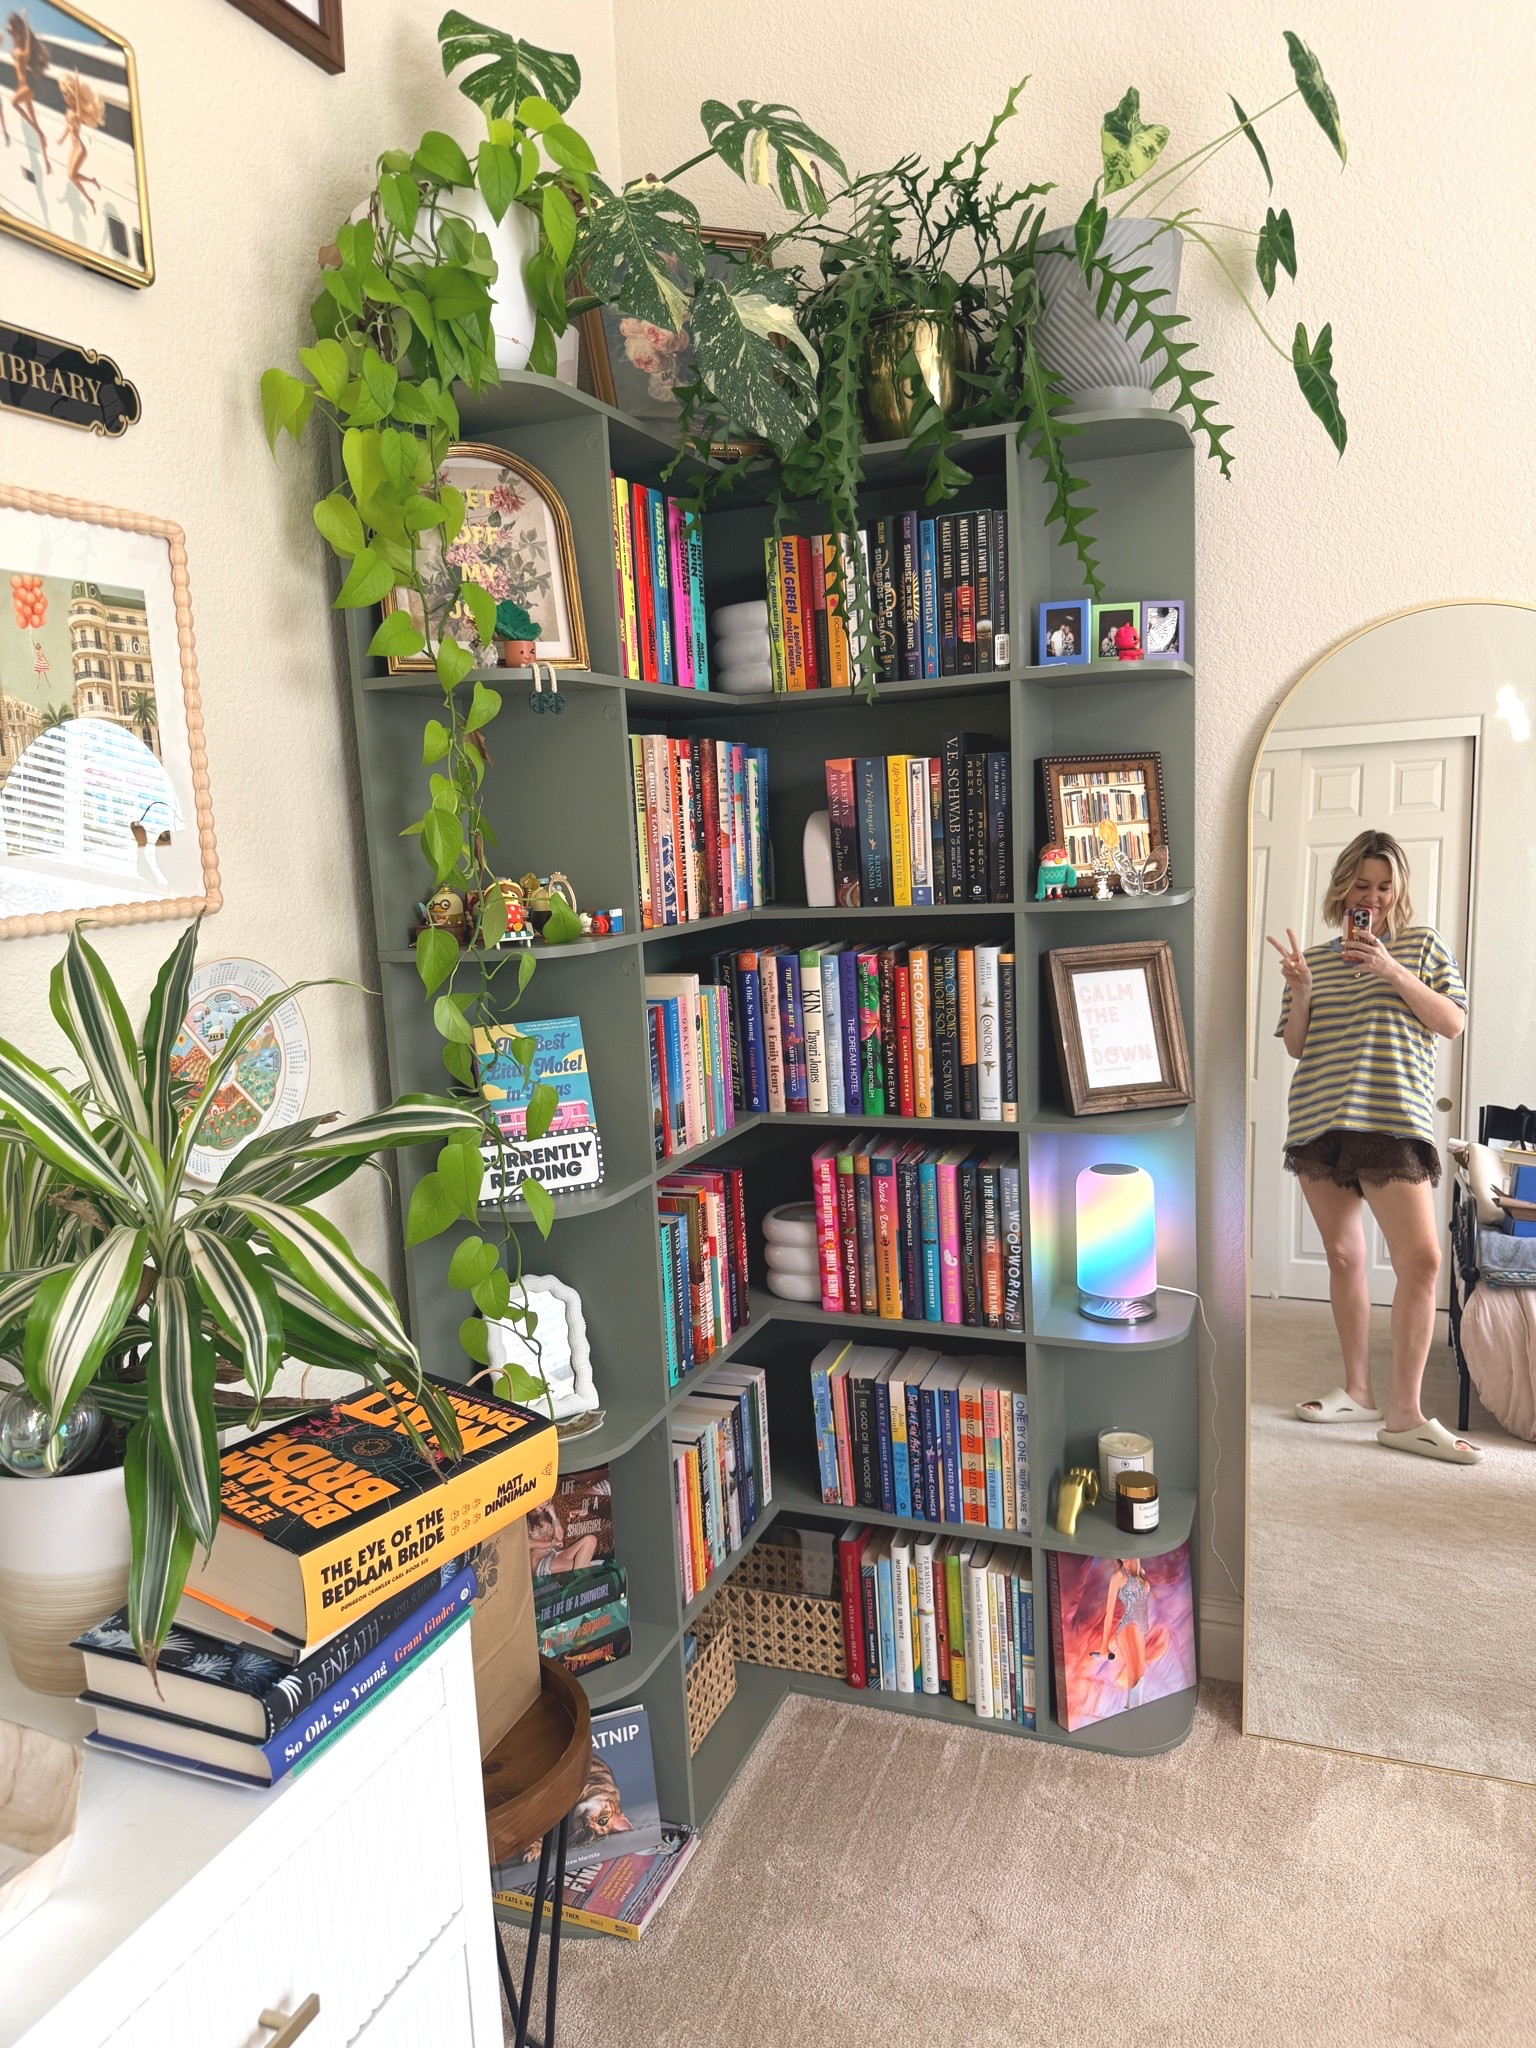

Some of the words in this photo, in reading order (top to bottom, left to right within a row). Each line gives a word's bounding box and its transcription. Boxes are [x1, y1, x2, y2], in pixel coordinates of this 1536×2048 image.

[0, 352, 102, 407] IBRARY
[466, 488, 495, 508] ET
[454, 525, 498, 545] OFF
[978, 515, 987, 547] MARGARET
[690, 543, 698, 578] RUIN
[782, 541, 796, 574] HANK
[904, 544, 914, 583] SUNRISE
[978, 548, 988, 573] ATWOOD
[461, 562, 498, 582] MY
[875, 547, 884, 599] SONGBIRDS
[784, 576, 798, 615] GREEN
[885, 581, 893, 618] BALLAD
[906, 585, 912, 593] ON
[924, 569, 934, 635] MOCKINGJAY
[833, 617, 841, 643] OCTAVIA
[878, 616, 887, 653] SNAKES
[886, 619, 893, 629] OF
[906, 609, 914, 650] REAPING
[787, 644, 796, 676] ENDEAVOR
[793, 631, 803, 668] BEAUTIFULLY
[946, 736, 958, 749] V.
[947, 752, 958, 765] E.
[649, 772, 657, 808] BRIGHT
[865, 773, 873, 788] The
[830, 774, 839, 817] HANNAH
[840, 773, 849, 816] KRISTIN
[948, 768, 961, 834] SCHWAB
[864, 789, 876, 834] Nightingale
[835, 827, 844, 848] Great
[977, 812, 985, 875] PROJECT
[835, 850, 844, 872] Alone
[867, 854, 875, 890] HANNAH
[874, 855, 882, 888] KRISTIN
[744, 973, 753, 985] So
[825, 962, 834, 981] The
[912, 957, 923, 979] THE
[803, 989, 822, 1014] KIN
[826, 981, 835, 1015] Names
[1079, 983, 1134, 1005] CALM
[746, 1004, 754, 1016] So
[913, 981, 926, 1051] COMPOUND
[1081, 1006, 1120, 1025] THE
[747, 1017, 755, 1042] Young
[847, 1017, 855, 1034] THE
[979, 1014, 995, 1058] CONFORM
[1088, 1027, 1099, 1045] F
[534, 1031, 570, 1052] Best
[768, 1033, 778, 1063] Emily
[807, 1030, 821, 1057] Tayari
[848, 1035, 857, 1066] DREAM
[886, 1044, 895, 1064] IAN
[1092, 1044, 1153, 1066] DOWN
[486, 1062, 526, 1082] Litt
[534, 1053, 583, 1076] Motel
[729, 1038, 739, 1073] GUEST
[829, 1039, 839, 1079] Florence
[770, 1064, 780, 1096] Henry
[809, 1058, 822, 1084] Jones
[850, 1067, 859, 1095] HOTEL
[506, 1085, 521, 1102] in
[732, 1075, 741, 1096] LIST
[830, 1080, 840, 1108] Knapp
[887, 1067, 896, 1108] McEWAN
[490, 1160, 582, 1190] READING
[820, 1163, 830, 1182] GREAT
[983, 1175, 993, 1184] TO
[822, 1182, 831, 1194] BIG
[878, 1179, 889, 1203] Sunk
[983, 1184, 993, 1198] THE
[823, 1195, 834, 1227] BEAUTIFUL
[983, 1199, 994, 1216] MOON
[825, 1227, 835, 1241] LIFE
[879, 1213, 889, 1238] Love
[984, 1216, 995, 1235] AND
[844, 1238, 853, 1264] Mad
[986, 1235, 996, 1254] BACK
[825, 1249, 838, 1273] EMILY
[1004, 1209, 1022, 1322] WOODWORKING
[828, 1274, 840, 1299] HENRY
[846, 1264, 857, 1299] Mabel
[759, 1390, 767, 1419] STEPHEN
[859, 1398, 867, 1409] THE
[1015, 1400, 1026, 1425] ONE
[860, 1410, 868, 1430] GOD
[965, 1394, 976, 1449] INTERMEZZO
[1016, 1426, 1026, 1439] BY
[861, 1432, 868, 1442] OF
[862, 1443, 870, 1454] THE
[1017, 1440, 1027, 1464] ONE
[244, 1433, 401, 1512] BRIDE
[863, 1455, 872, 1488] WOODS
[967, 1460, 977, 1487] SALLY
[1018, 1469, 1026, 1485] RUTH
[220, 1450, 352, 1530] BEDLAM
[484, 1477, 537, 1517] DINNIMAN
[496, 1473, 523, 1498] MATT
[561, 1479, 576, 1495] LIFE
[948, 1483, 956, 1512] RIVALRY
[593, 1495, 599, 1510] A
[968, 1488, 979, 1522] ROONEY
[1019, 1486, 1027, 1513] WARE
[567, 1518, 603, 1538] SHOWGIRL
[320, 1560, 353, 1586] THE
[357, 1540, 385, 1567] EYE
[390, 1527, 413, 1549] OF
[423, 1507, 445, 1535] THE
[322, 1559, 393, 1610] BEDLAM
[397, 1525, 445, 1568] BRIDE
[340, 1591, 367, 1612] DUNGEON
[367, 1579, 390, 1600] CRAWLER
[390, 1573, 405, 1588] CARL
[405, 1564, 420, 1581] BOOK
[420, 1557, 429, 1569] SIX
[895, 1559, 903, 1605] MOTHERHOOD
[541, 1606, 552, 1621] THE
[551, 1600, 565, 1616] LIFE
[565, 1596, 574, 1612] OF
[573, 1594, 580, 1607] A
[580, 1583, 610, 1606] SHOWGIRL
[897, 1607, 903, 1617] SO
[307, 1619, 380, 1701] BENEATH
[284, 1740, 303, 1762] So
[333, 1698, 350, 1718] So
[350, 1661, 388, 1700] Young
[393, 1631, 422, 1663] Grant
[423, 1601, 456, 1635] Ginder
[590, 1723, 640, 1750] ATNIP
